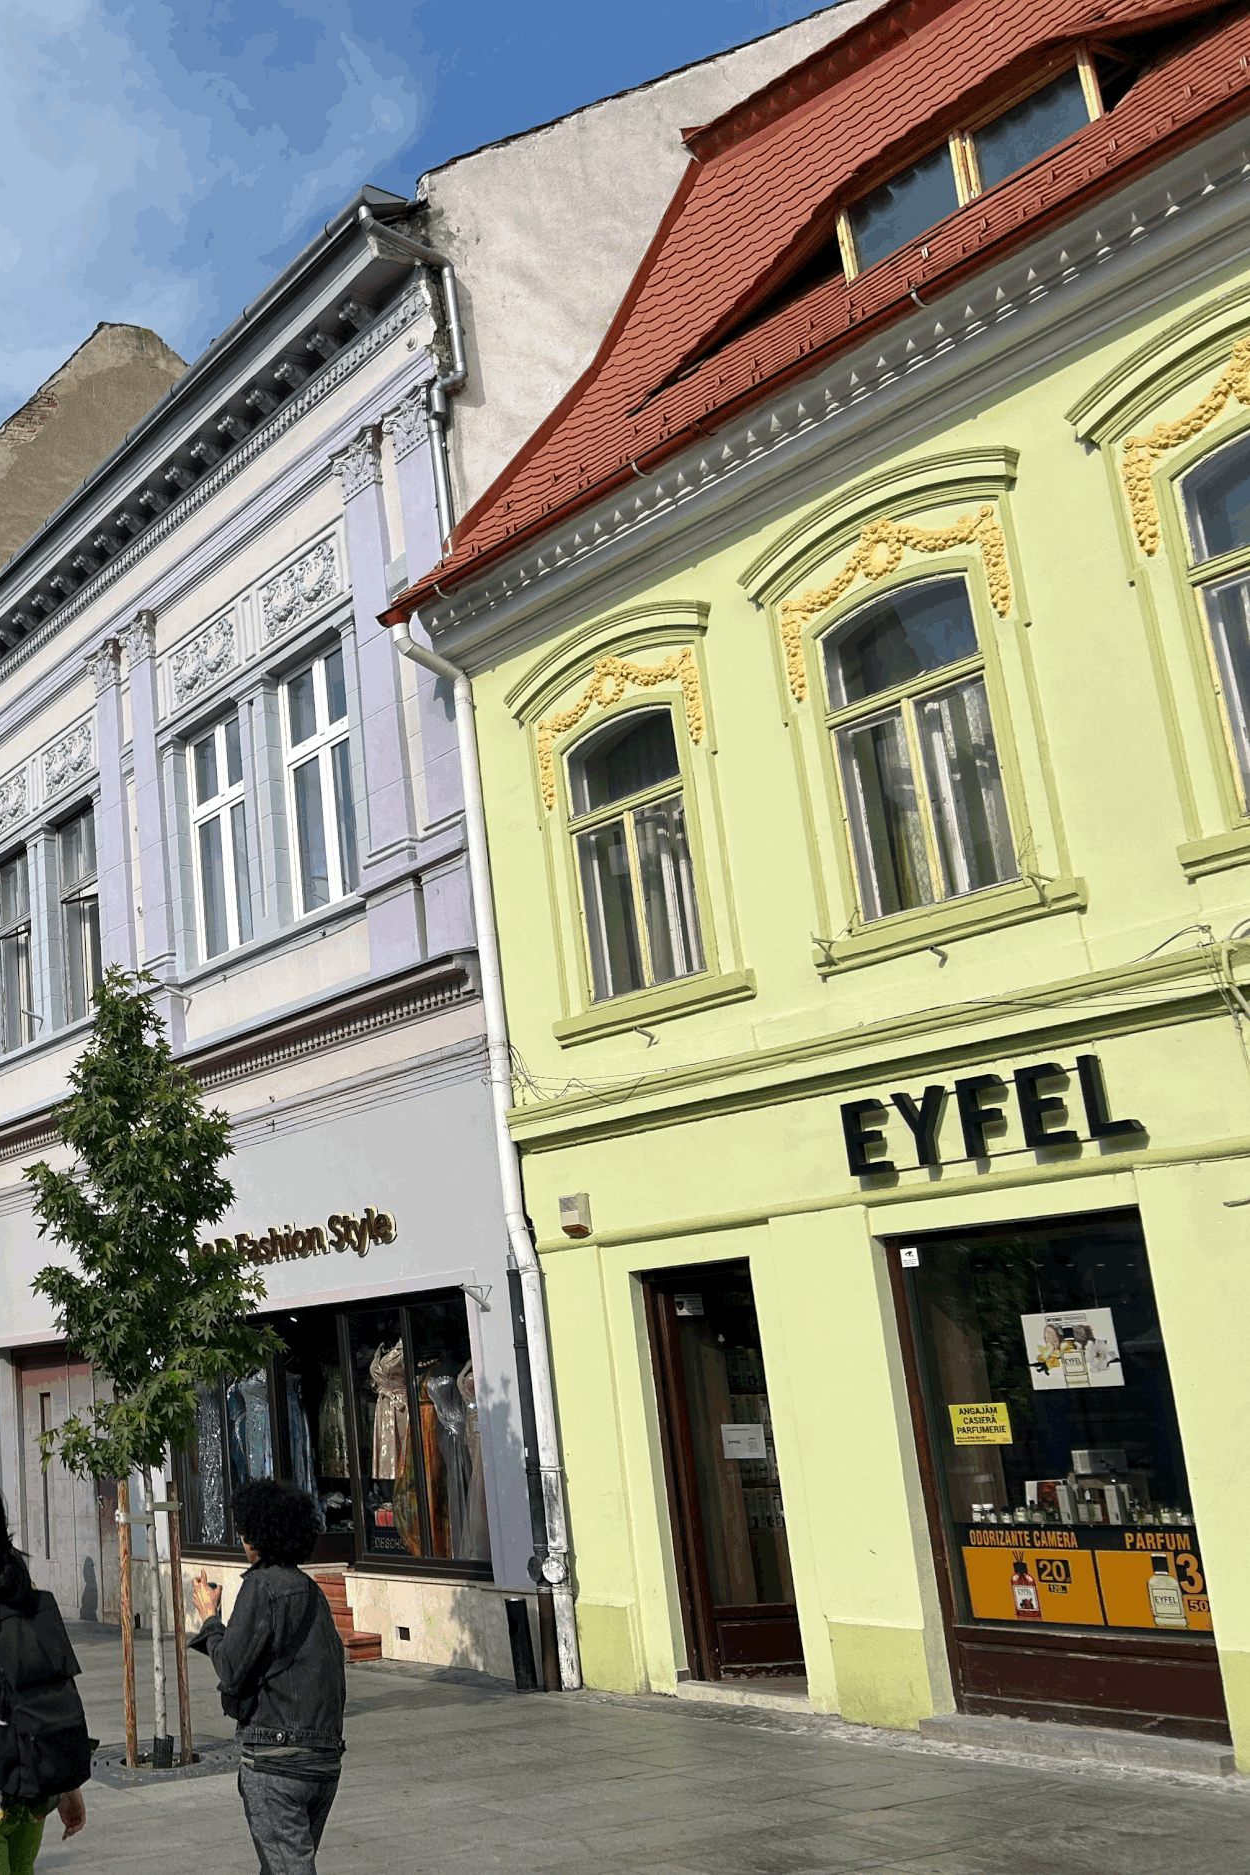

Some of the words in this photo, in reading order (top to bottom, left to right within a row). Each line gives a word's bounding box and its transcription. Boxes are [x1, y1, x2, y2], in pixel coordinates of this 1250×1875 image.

[840, 1054, 1146, 1177] EYFEL
[235, 1223, 325, 1263] Fashion
[328, 1207, 393, 1253] Style
[956, 1425, 1007, 1434] PARFUMERIE
[969, 1530, 1031, 1547] ODORIZANTE
[1033, 1531, 1078, 1548] CAMERA
[1124, 1533, 1191, 1551] PARFUM
[1038, 1560, 1066, 1582] 20
[1154, 1596, 1178, 1604] EYFEL
[1189, 1600, 1209, 1612] 50
